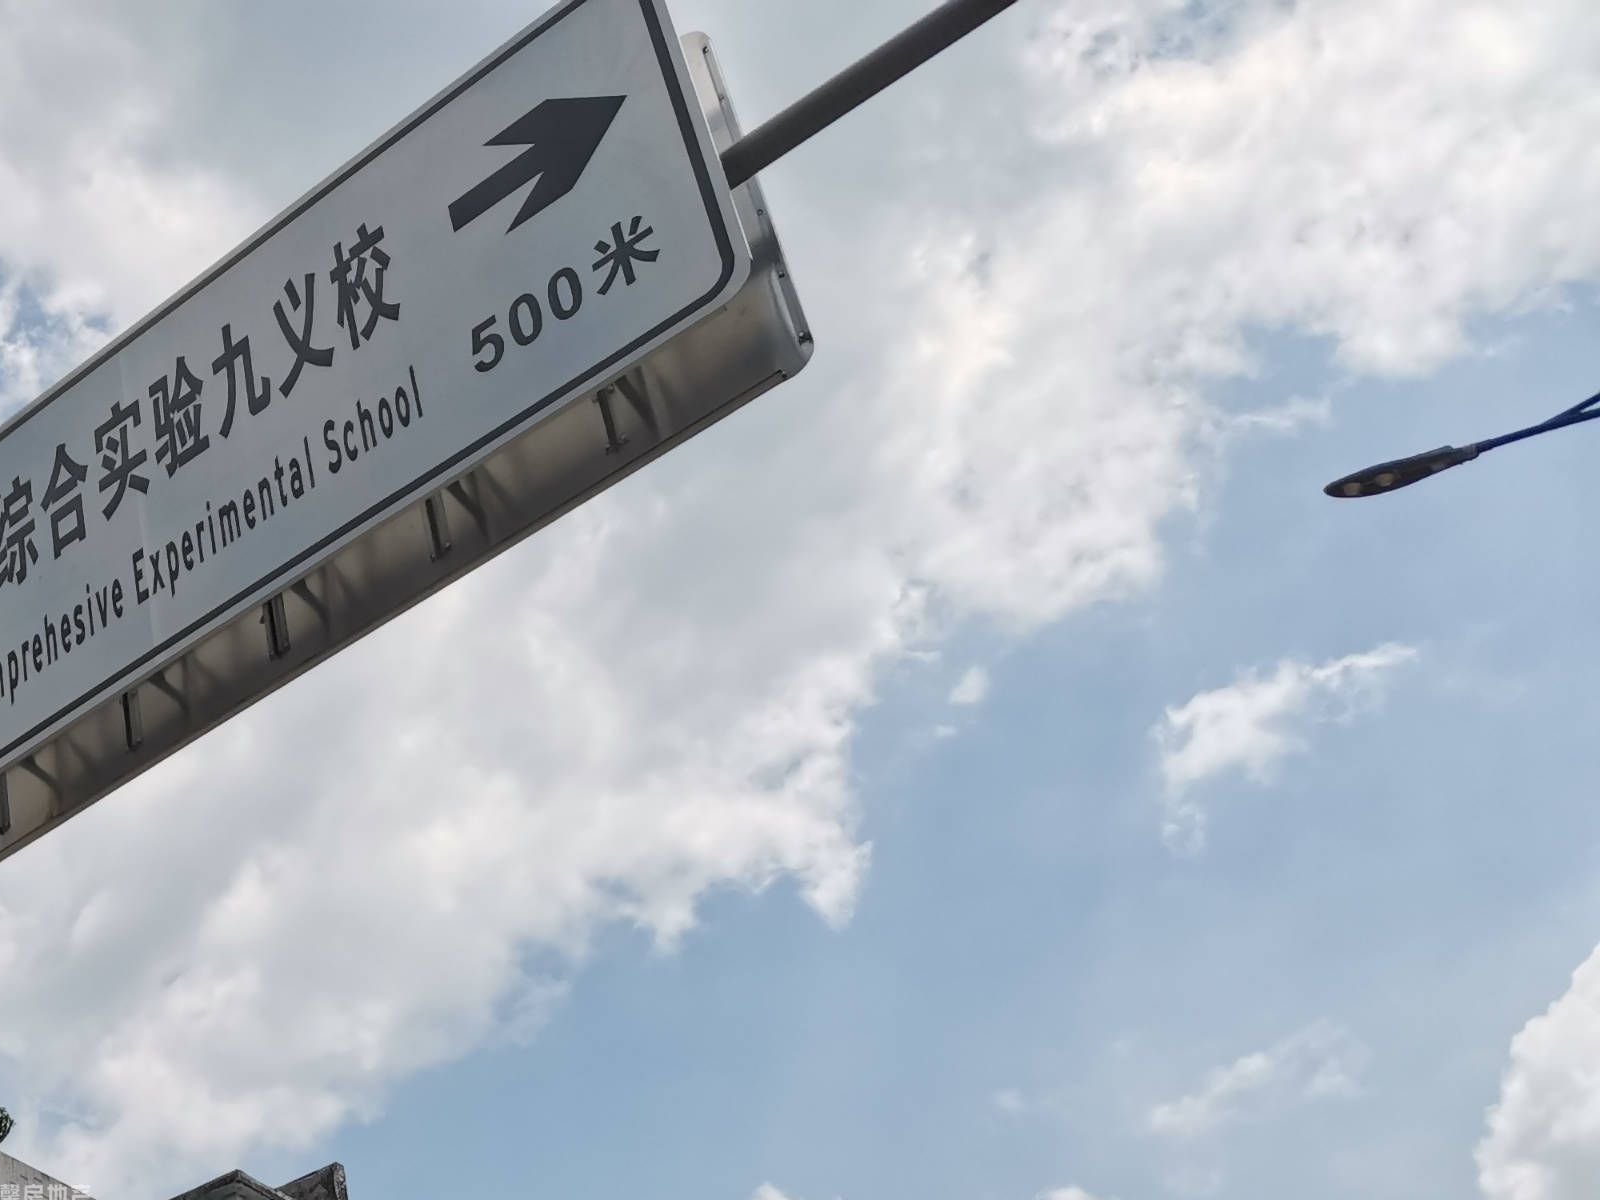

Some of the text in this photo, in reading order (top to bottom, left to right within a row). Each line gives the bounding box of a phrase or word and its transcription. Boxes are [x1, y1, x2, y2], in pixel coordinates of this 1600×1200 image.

[468, 215, 661, 374] 500米
[131, 434, 316, 606] Experimental
[323, 364, 424, 475] School
